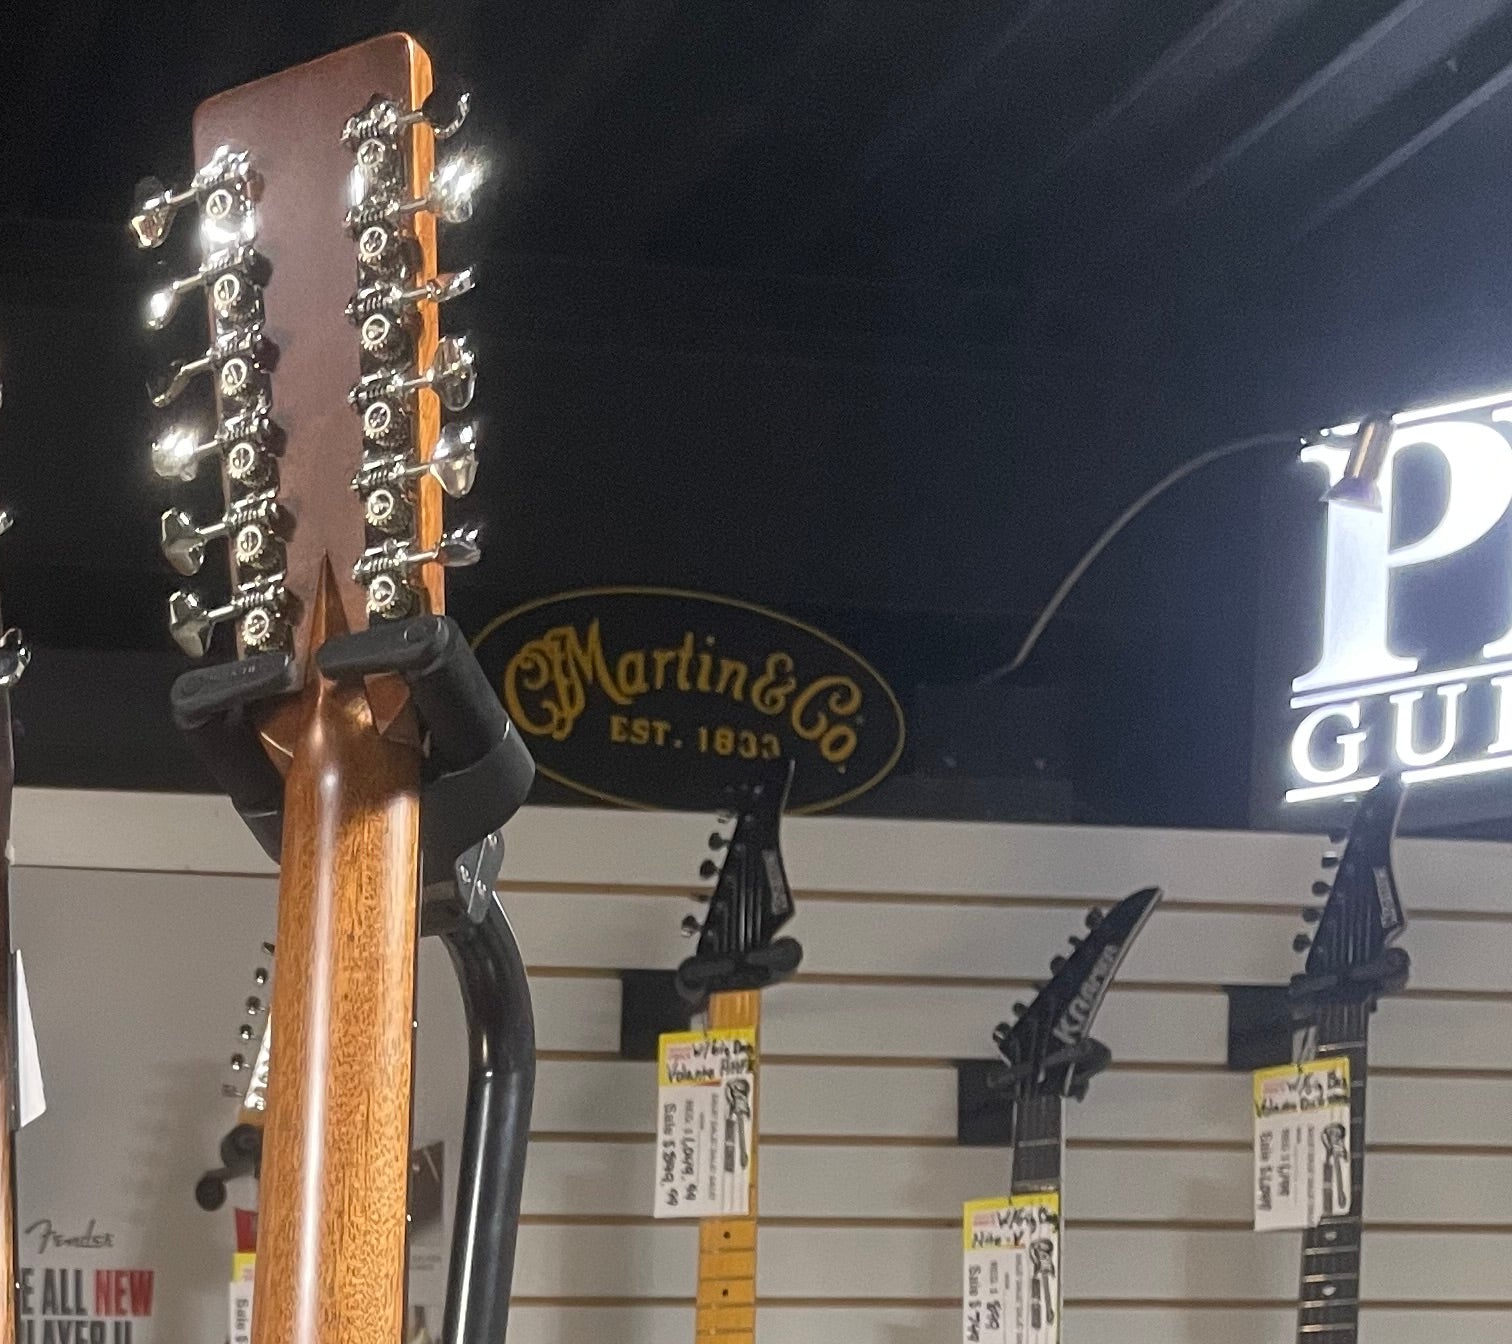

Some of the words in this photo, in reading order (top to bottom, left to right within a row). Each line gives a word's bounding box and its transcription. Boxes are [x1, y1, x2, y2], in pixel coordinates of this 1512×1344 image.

[610, 715, 682, 749] EST.
[663, 1102, 677, 1135] Sale
[25, 1218, 116, 1254] Fender
[41, 1268, 88, 1316] ALL
[93, 1269, 155, 1317] NEW
[236, 1298, 249, 1331] Sale
